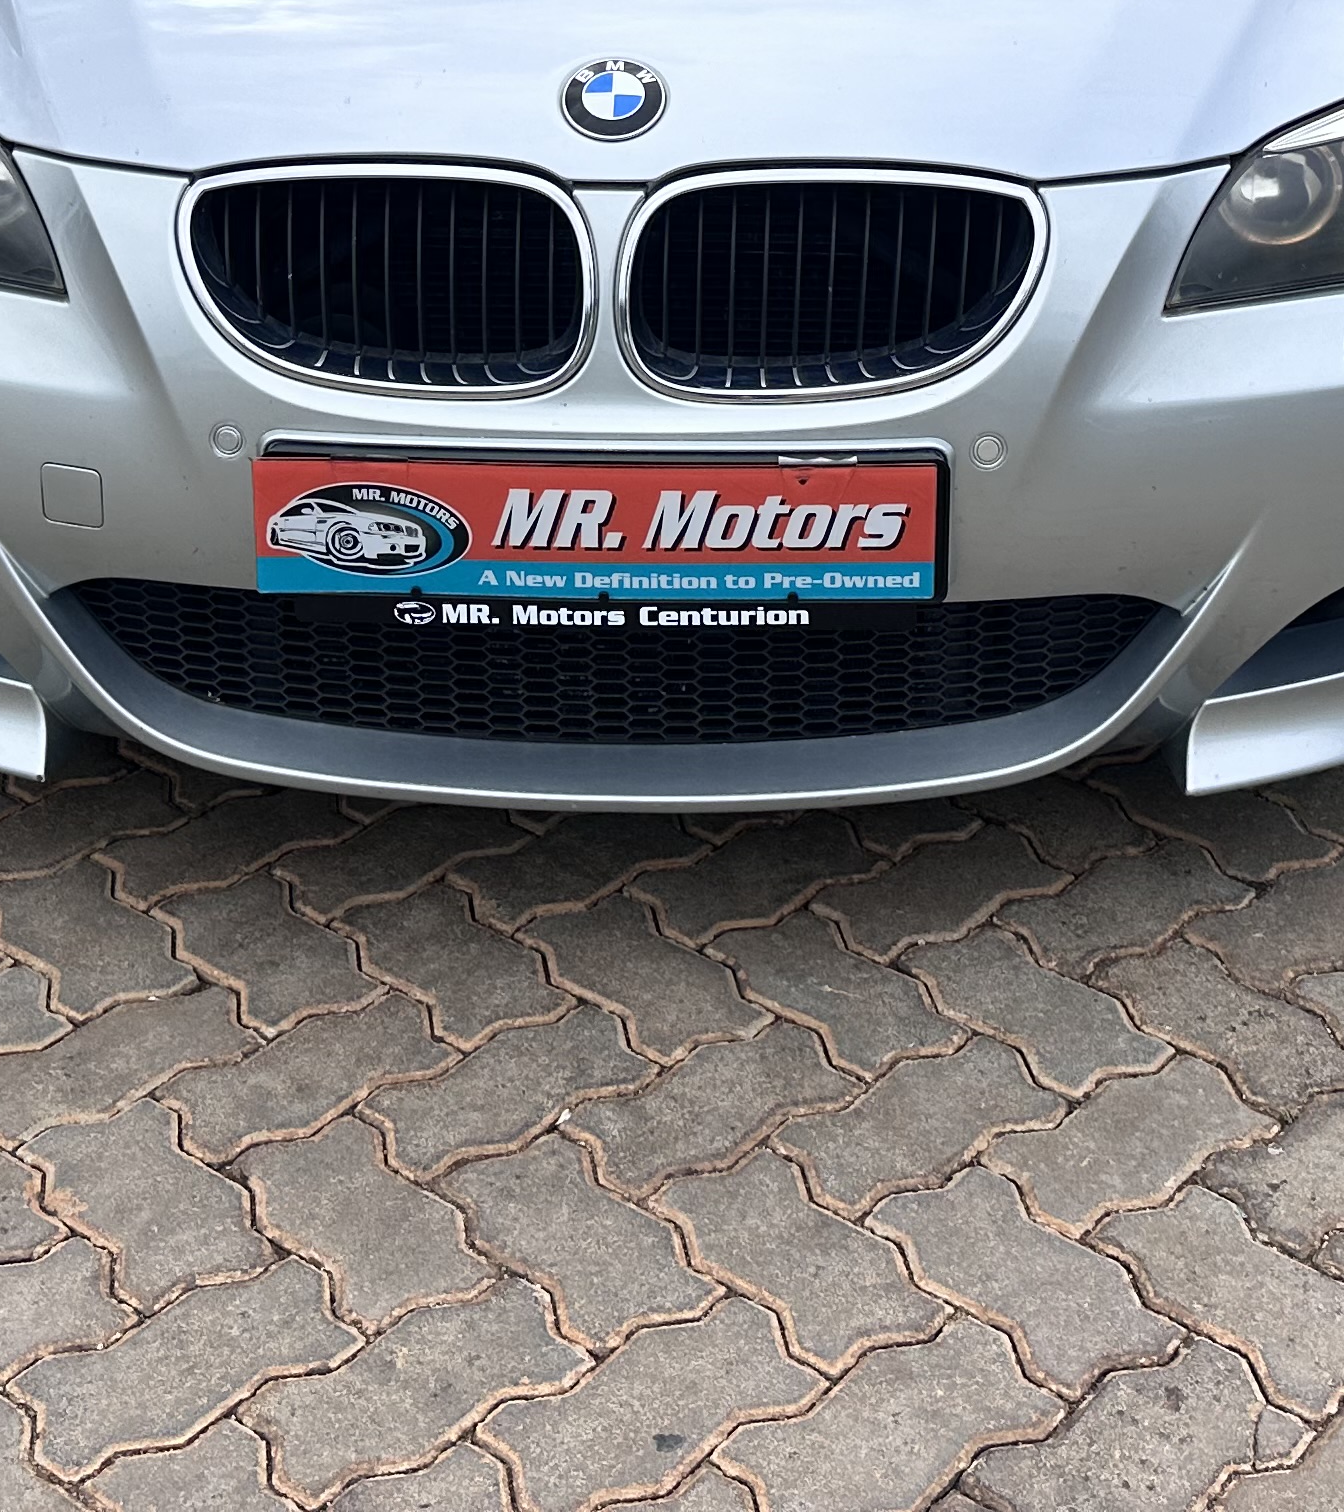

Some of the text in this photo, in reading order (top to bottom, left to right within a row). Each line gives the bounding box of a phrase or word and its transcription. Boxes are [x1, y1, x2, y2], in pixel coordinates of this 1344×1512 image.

[574, 59, 658, 85] BMW
[352, 488, 460, 531] MR. MOTORS
[491, 487, 910, 551] MR. Motors
[477, 569, 921, 590] A New Definition to Pre-Owned
[441, 603, 810, 627] MR. Motors Centurion
